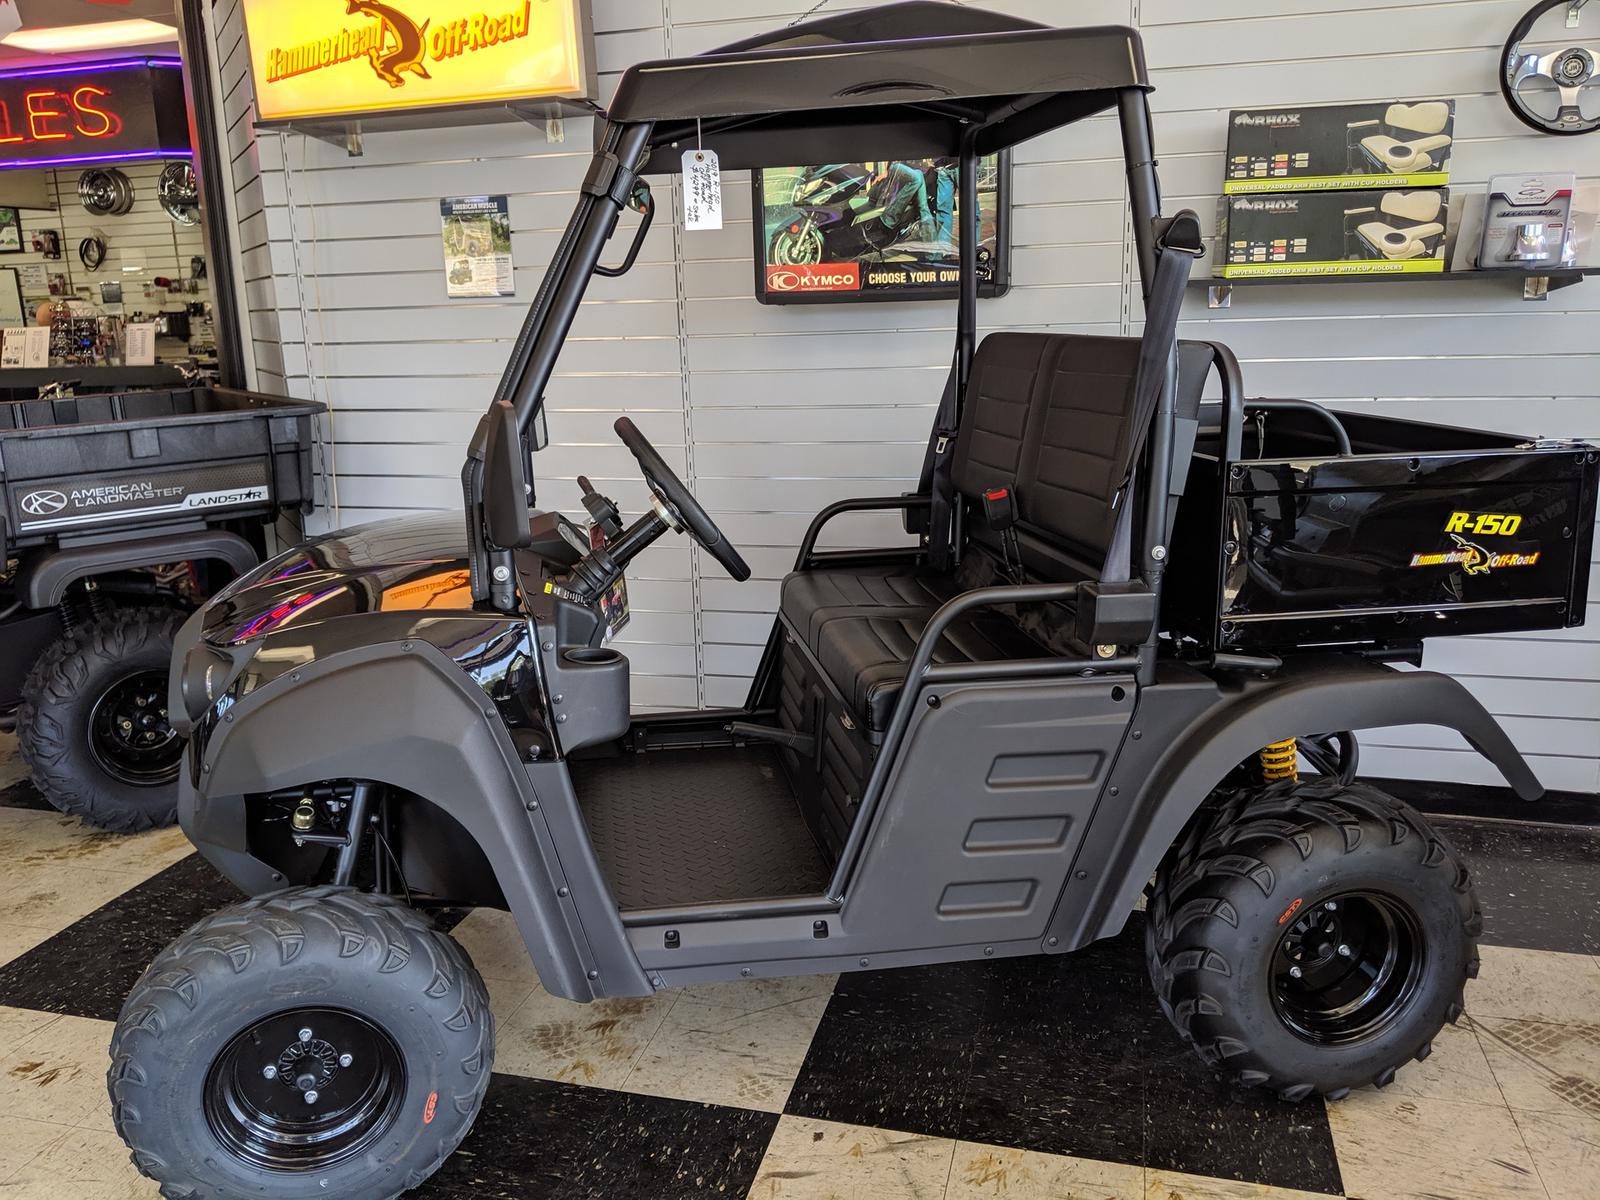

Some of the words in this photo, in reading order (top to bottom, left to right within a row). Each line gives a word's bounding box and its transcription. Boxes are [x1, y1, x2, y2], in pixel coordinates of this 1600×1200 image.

[266, 17, 386, 83] Hammerhead
[429, 0, 531, 61] Off-Road
[801, 274, 855, 286] KYMCO
[868, 272, 906, 284] CHOOSE
[910, 271, 937, 283] YOUR
[70, 482, 153, 500] AMERICAN
[75, 486, 182, 508] LANDMASTER
[189, 490, 262, 508] LANDSTAR
[1444, 512, 1522, 536] R-150
[1409, 551, 1473, 568] Hammerhead
[1490, 552, 1541, 568] Off-Road
